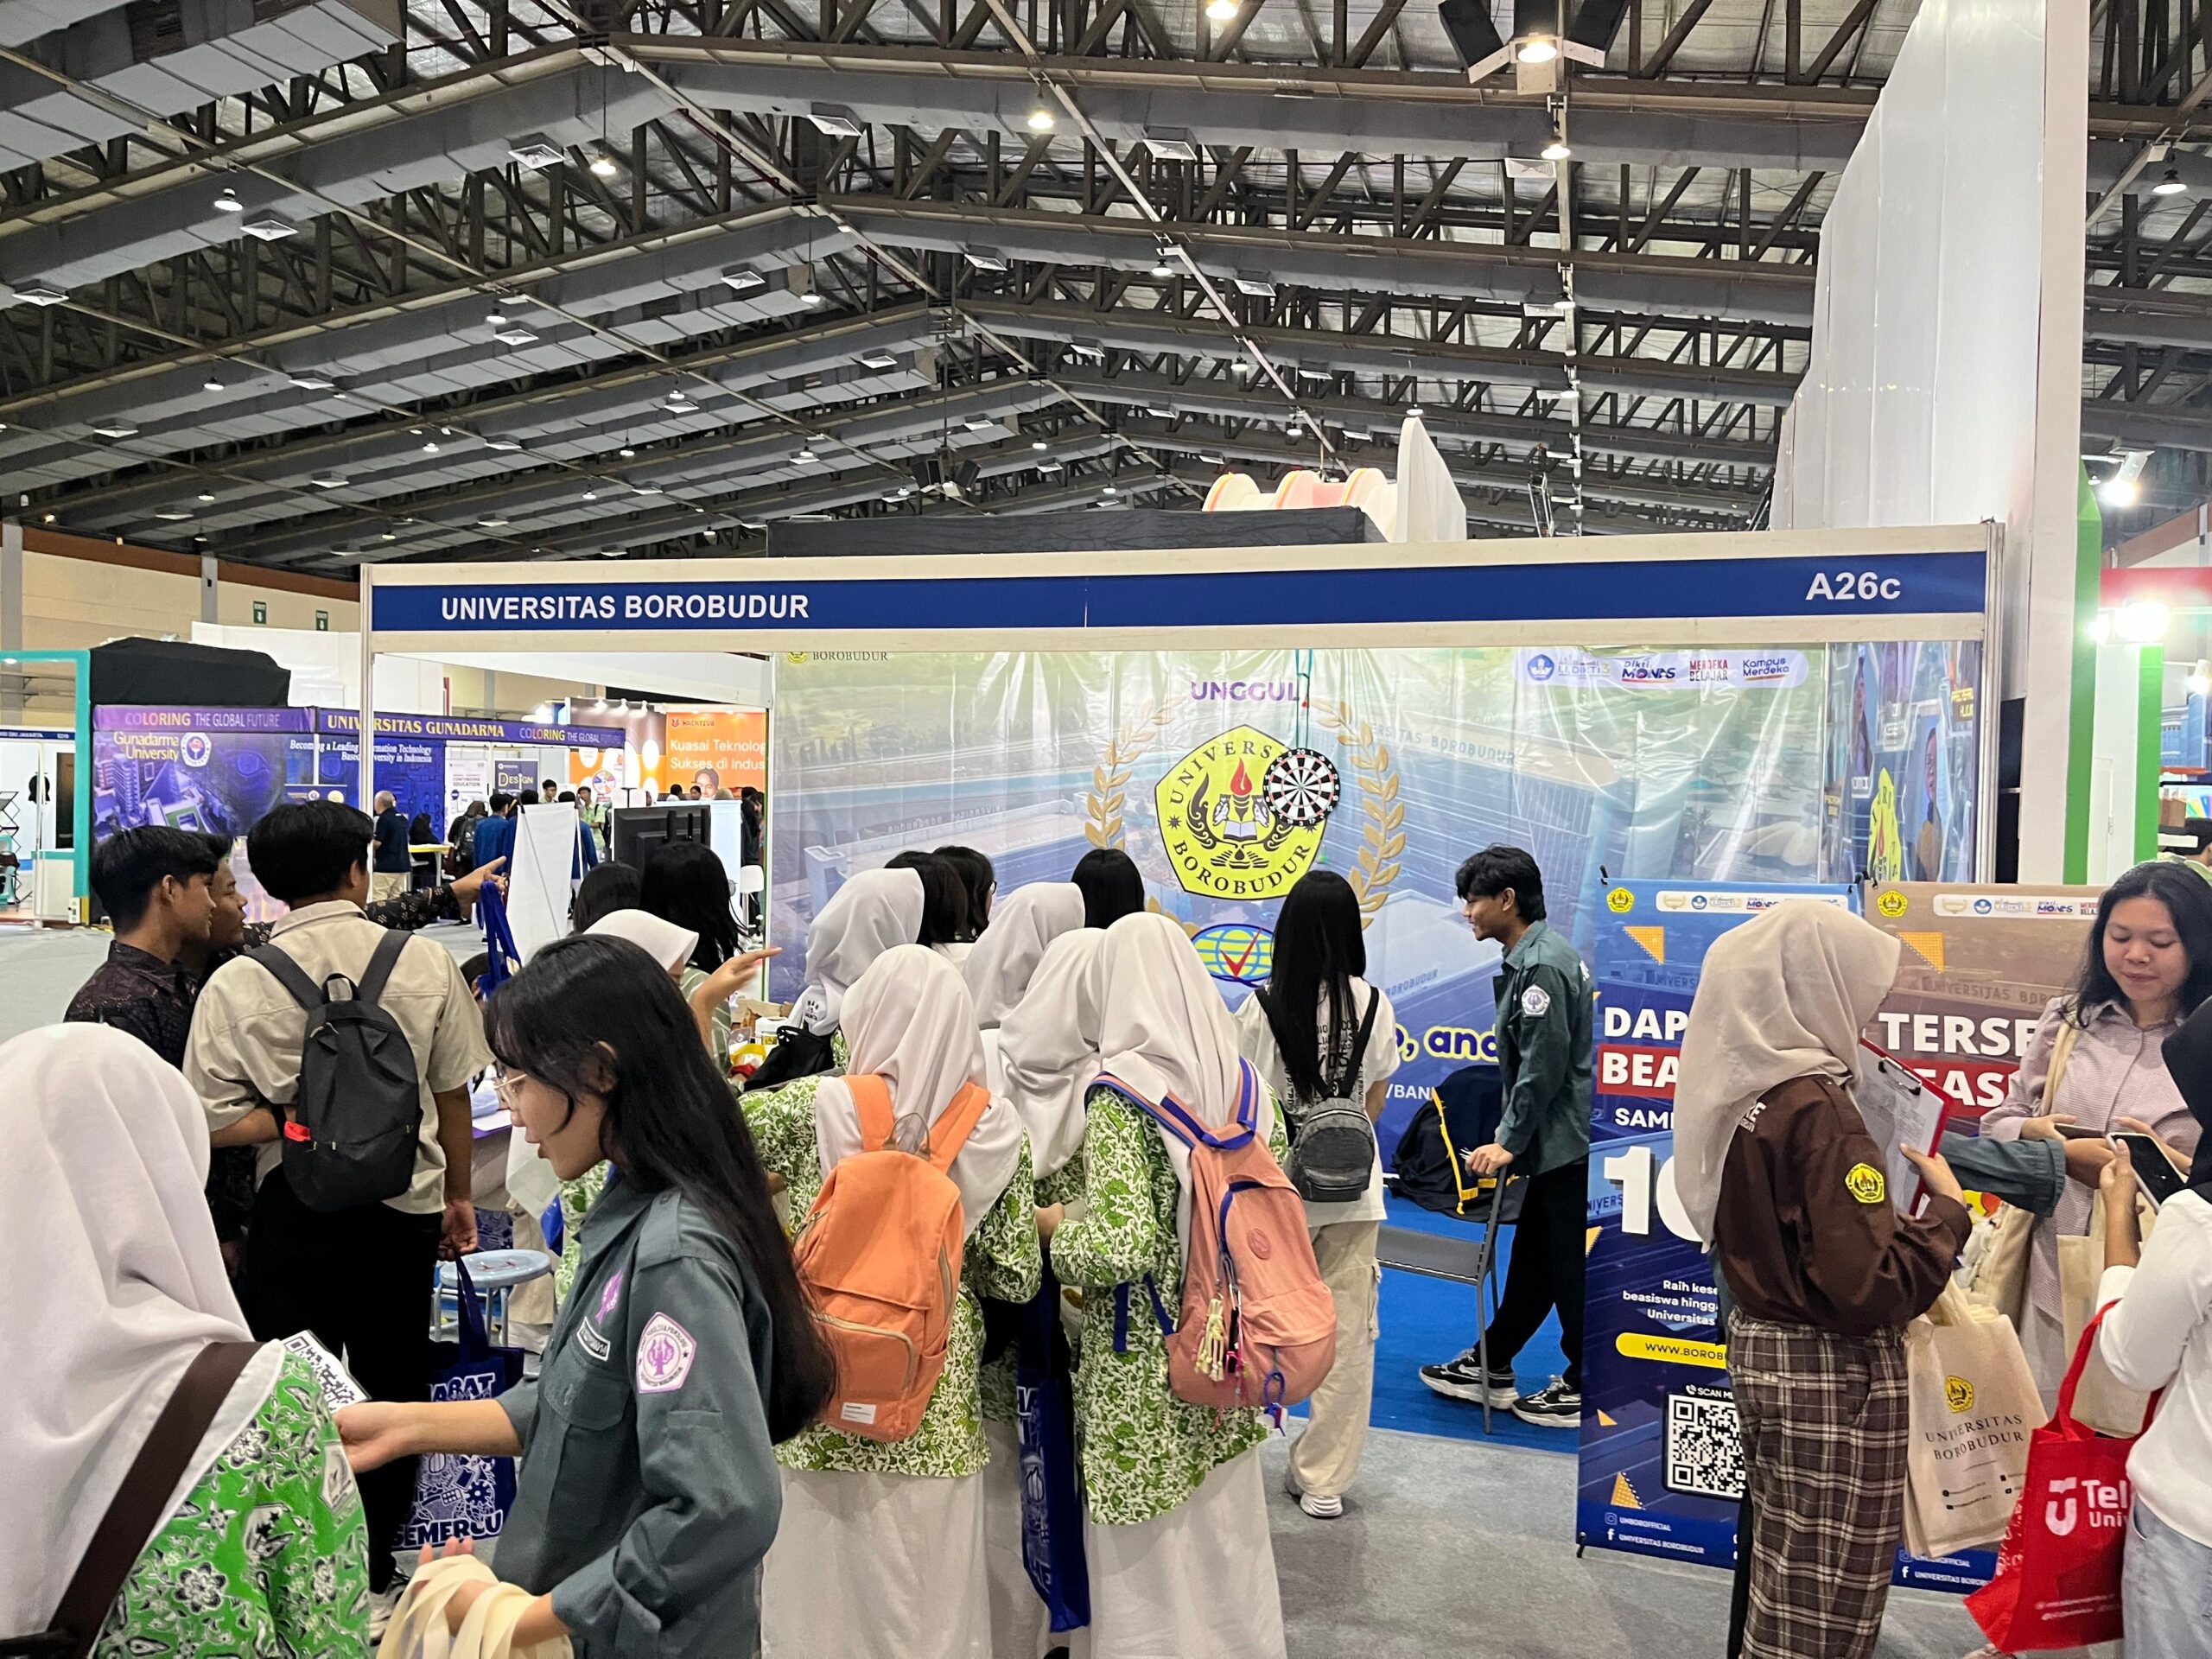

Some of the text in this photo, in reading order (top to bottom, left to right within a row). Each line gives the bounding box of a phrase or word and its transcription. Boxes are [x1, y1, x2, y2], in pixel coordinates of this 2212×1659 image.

[1806, 572, 1900, 601] A26c
[442, 594, 809, 620] UNIVERSITAS BOROBUDUR
[813, 651, 888, 661] BOROBUDUR
[1744, 658, 1785, 668] Kampus
[1744, 666, 1789, 677] Merdeka
[1192, 681, 1298, 702] UNGGUL
[125, 713, 280, 728] COLORING THE GLOBAL FUTURE
[327, 715, 505, 737] UNIVRSITAS GUNADARMA
[113, 731, 179, 746] Gunadarma
[519, 727, 565, 741] COLORING
[567, 732, 577, 741] THE
[578, 732, 600, 743] GLOBAL
[125, 746, 180, 761] University
[290, 739, 324, 753] Becomg
[373, 743, 397, 753] rmation
[671, 739, 766, 755] Kuasai Teknolog
[373, 753, 395, 764] versity
[671, 757, 766, 770] Sukses di Indus
[1169, 740, 1273, 804] UNIVERS
[1173, 840, 1311, 895] BOROBUDUR
[1385, 969, 1439, 996] BOROBUDUR
[1604, 1007, 1689, 1039] DAP
[1663, 1280, 1690, 1292] Raih
[1623, 1290, 1680, 1306] beasiswa
[1647, 1308, 1716, 1325] Universitas
[1645, 1343, 1725, 1360] WWW.BOROB
[430, 1372, 496, 1402] ARAT
[1697, 1387, 1722, 1398] SCAN
[1934, 1431, 2024, 1460] BOROBUDUR
[2082, 1479, 2128, 1509] Tel
